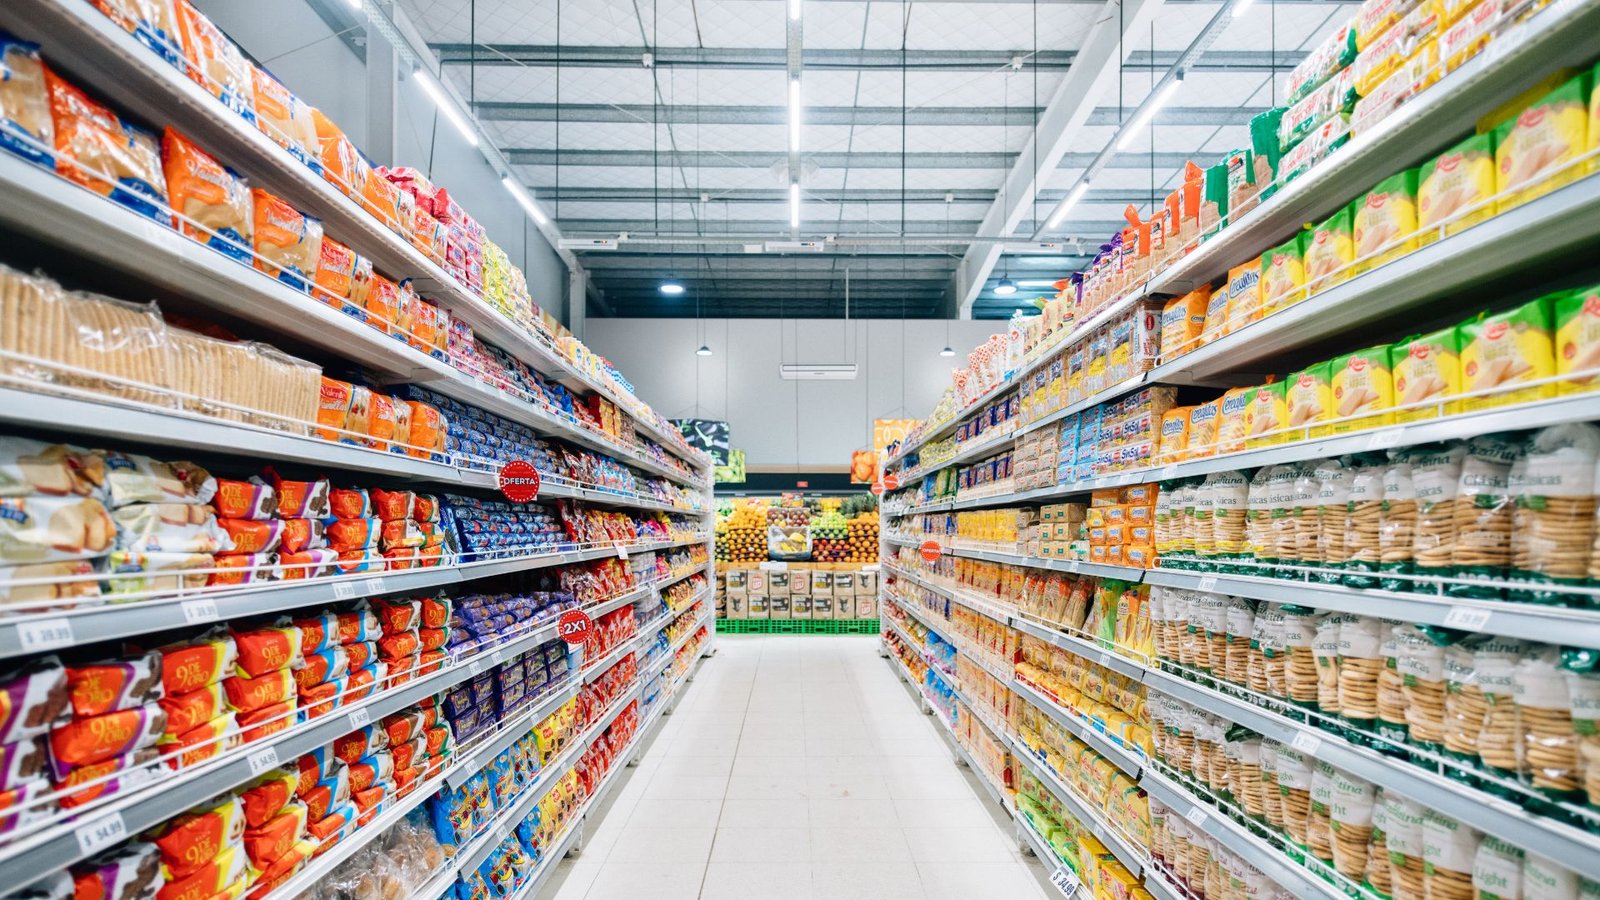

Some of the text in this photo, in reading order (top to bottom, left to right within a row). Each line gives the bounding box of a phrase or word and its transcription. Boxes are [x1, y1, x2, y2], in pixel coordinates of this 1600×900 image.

[503, 477, 535, 485] OFERTA
[564, 620, 587, 635] 2X1
[262, 645, 287, 666] 9 DE ORO
[176, 665, 188, 688] 9
[188, 662, 200, 673] DE
[254, 685, 265, 706] 9
[90, 717, 106, 744] 9
[185, 846, 199, 865] 9
[1058, 877, 1075, 896] 34.99
[1474, 864, 1508, 888] Light
